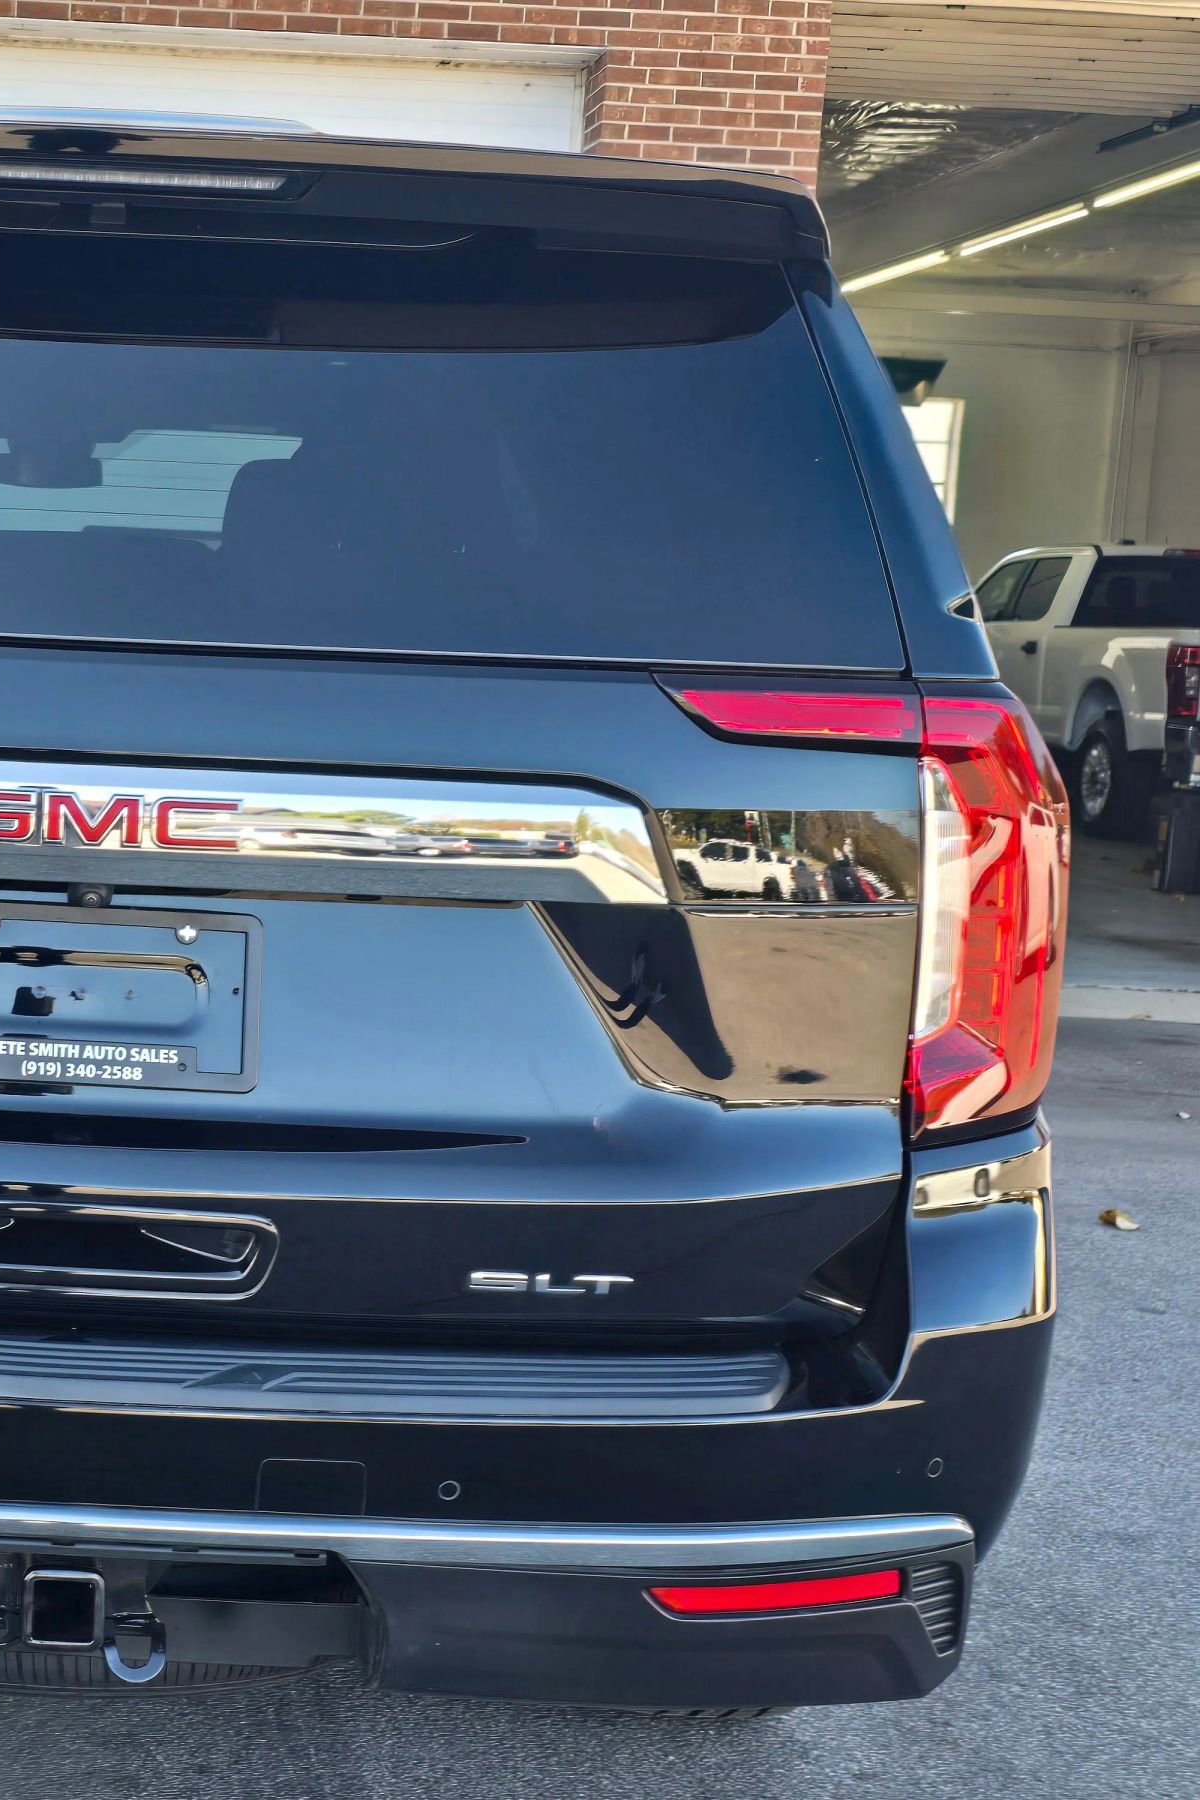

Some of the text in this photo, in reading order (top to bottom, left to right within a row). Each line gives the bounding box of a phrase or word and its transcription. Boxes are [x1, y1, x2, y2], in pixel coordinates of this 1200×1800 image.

[29, 1043, 80, 1059] SMITH
[82, 1046, 127, 1061] AUTO
[130, 1048, 178, 1064] SALES
[21, 1060, 143, 1081] (919) 340-2588
[469, 1270, 635, 1295] SLT
